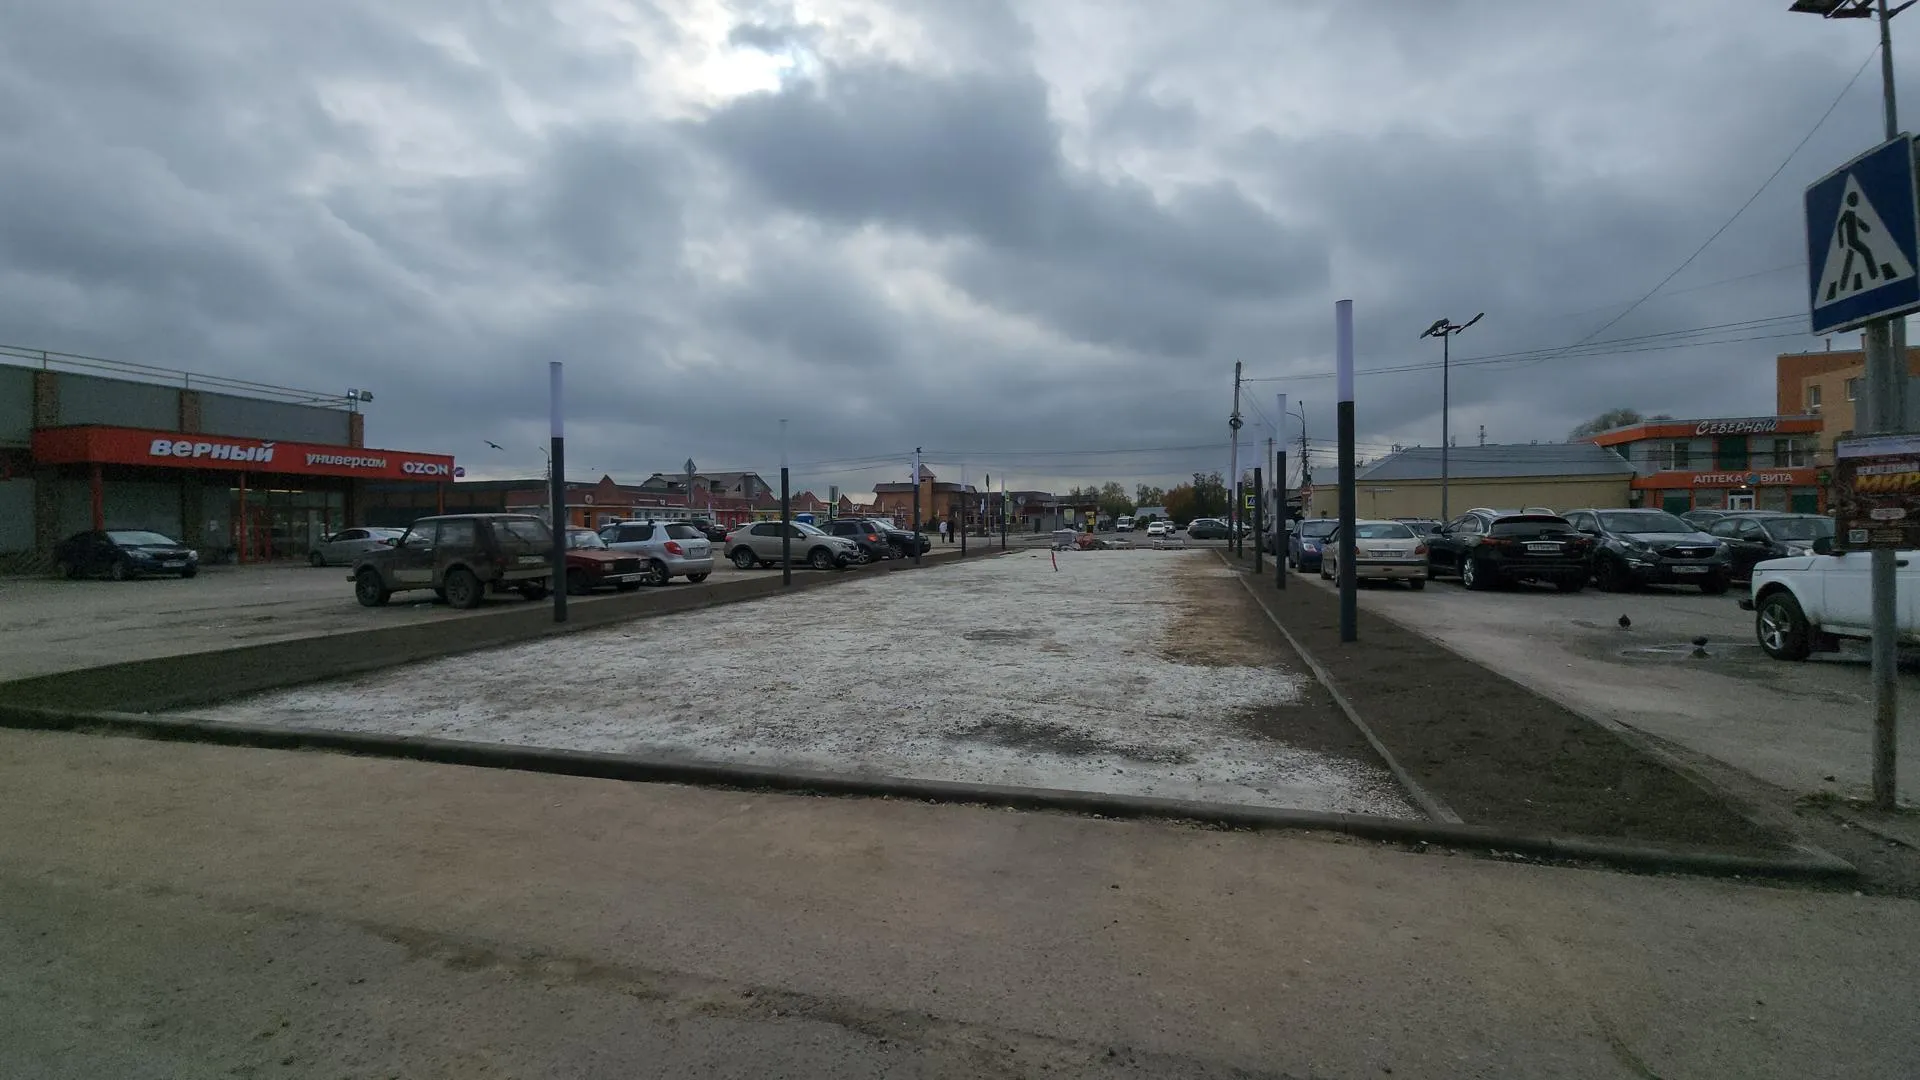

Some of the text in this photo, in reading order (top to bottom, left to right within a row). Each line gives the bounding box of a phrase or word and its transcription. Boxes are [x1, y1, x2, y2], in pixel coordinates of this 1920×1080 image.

[305, 452, 388, 469] универсам
[403, 461, 449, 475] OZON
[1693, 473, 1793, 484] АПТЕКА ВИТА
